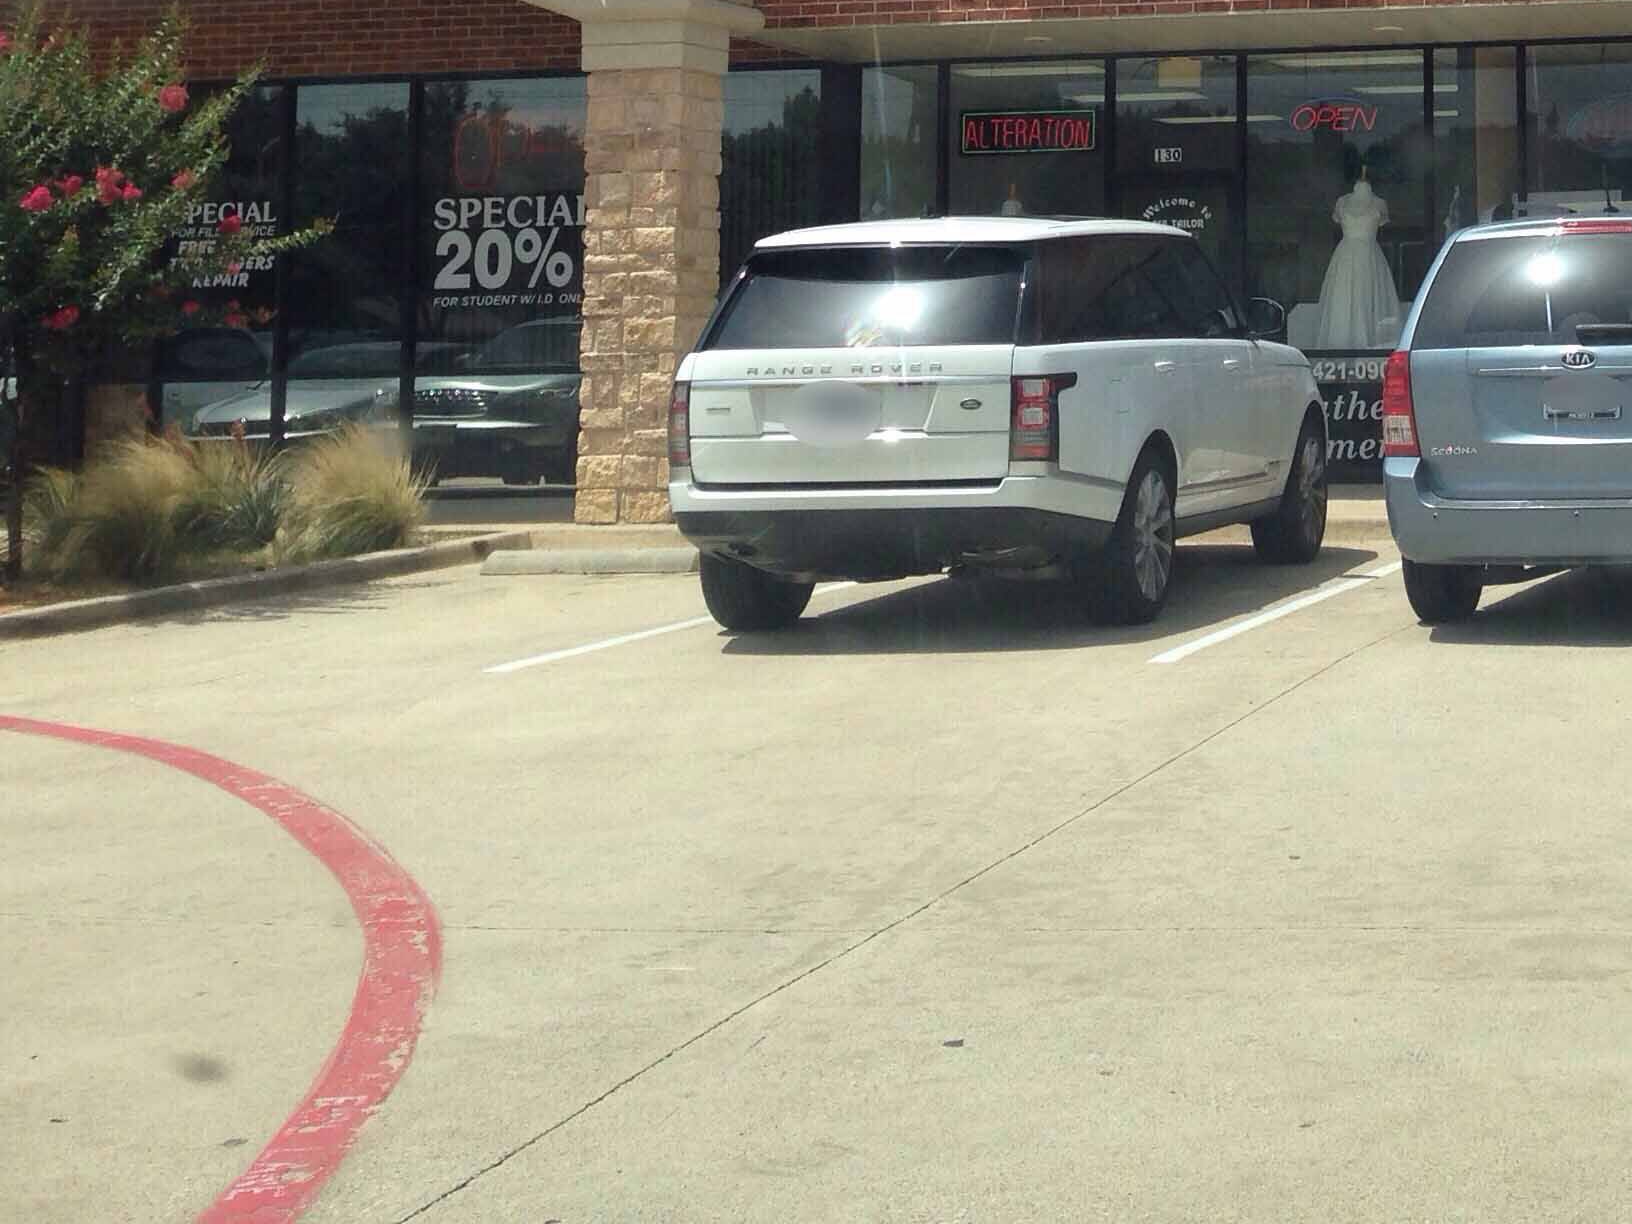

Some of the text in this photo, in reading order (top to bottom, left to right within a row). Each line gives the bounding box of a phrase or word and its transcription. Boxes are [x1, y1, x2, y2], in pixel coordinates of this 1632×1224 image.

[1290, 104, 1378, 132] OPEN
[966, 118, 1091, 148] ALTERATION
[1156, 149, 1181, 162] 130
[186, 200, 277, 224] PECIAL
[1143, 197, 1196, 219] Welcome
[434, 228, 574, 289] 20%
[433, 296, 458, 307] FOR
[462, 294, 516, 306] STUDENT
[1565, 353, 1591, 365] KIA
[746, 364, 943, 376] RANGE ROVER
[1312, 361, 1385, 380] 421-09
